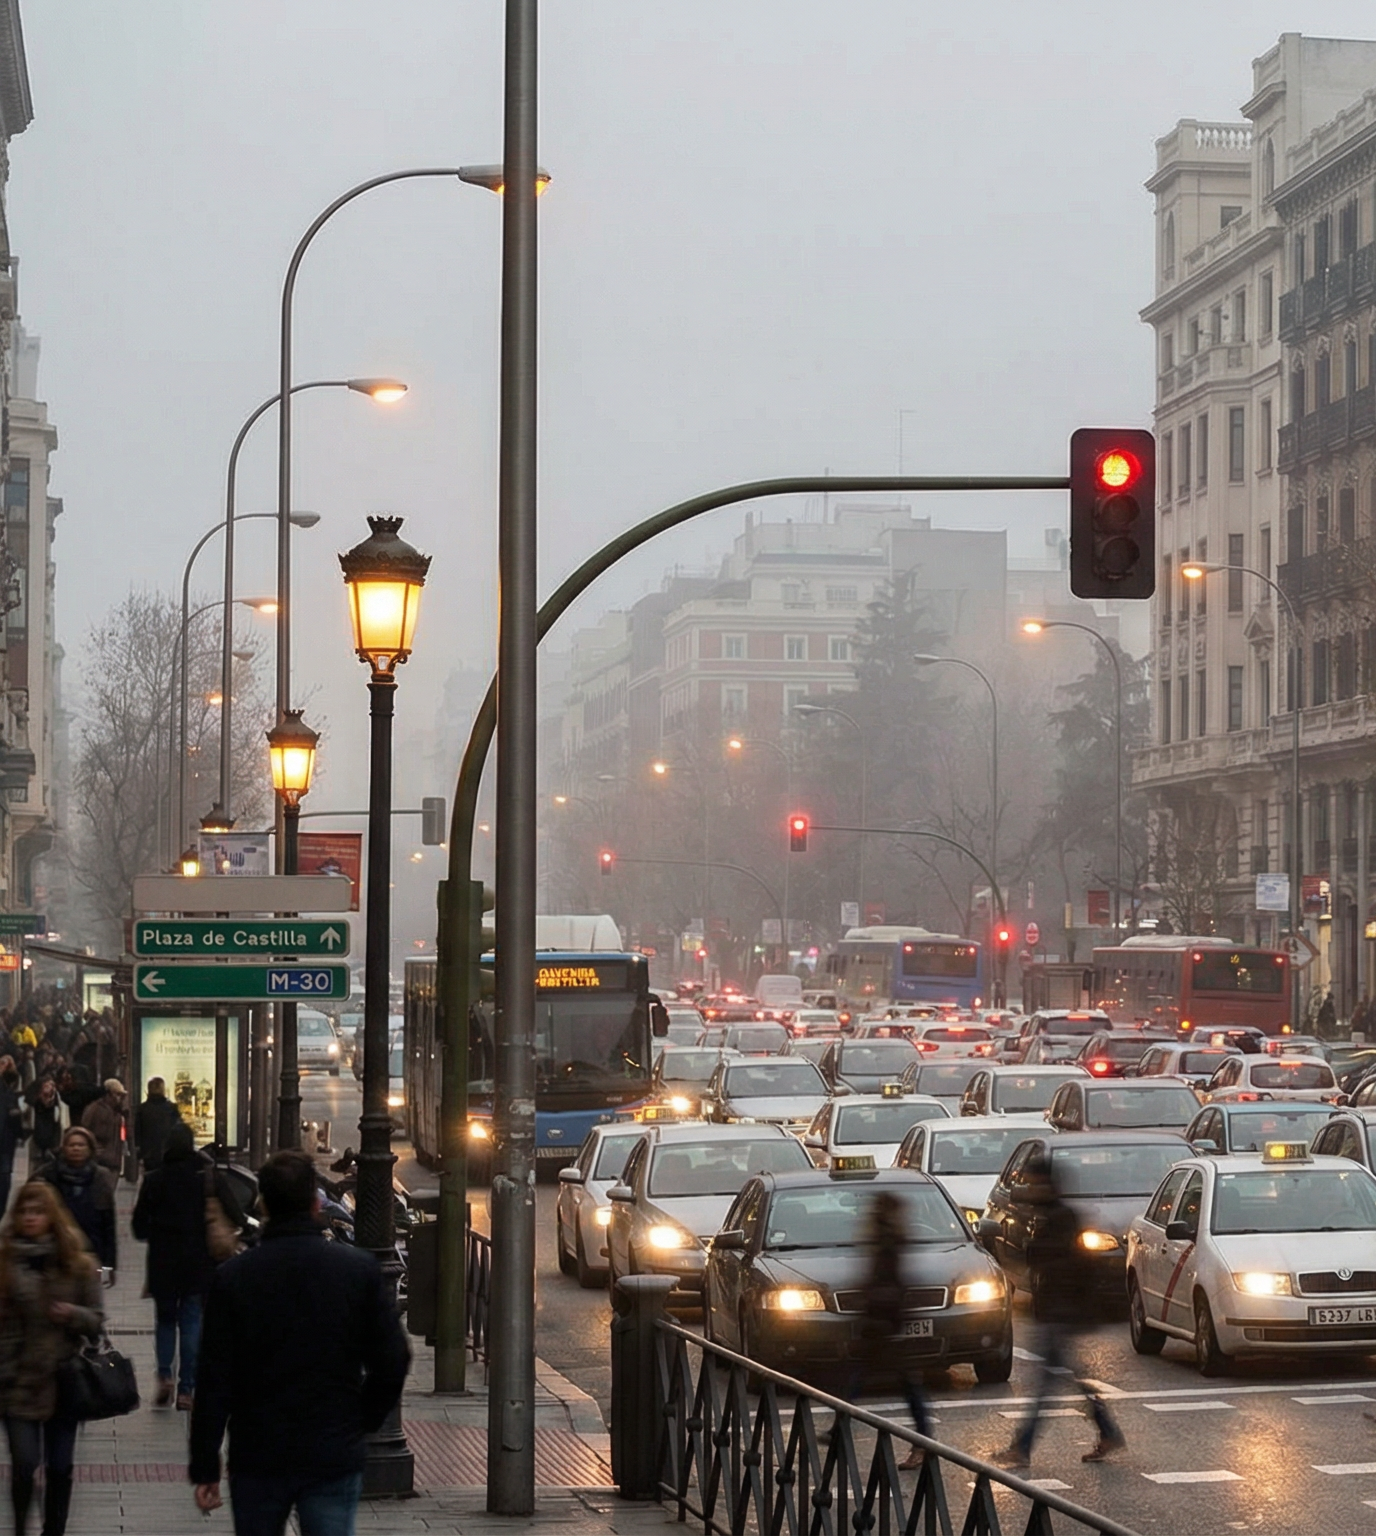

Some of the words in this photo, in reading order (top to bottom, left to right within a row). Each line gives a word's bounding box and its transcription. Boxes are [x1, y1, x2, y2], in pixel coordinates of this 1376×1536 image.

[142, 929, 194, 946] Plaza
[202, 930, 225, 946] de
[233, 930, 307, 946] Castilla
[271, 973, 329, 990] M-30
